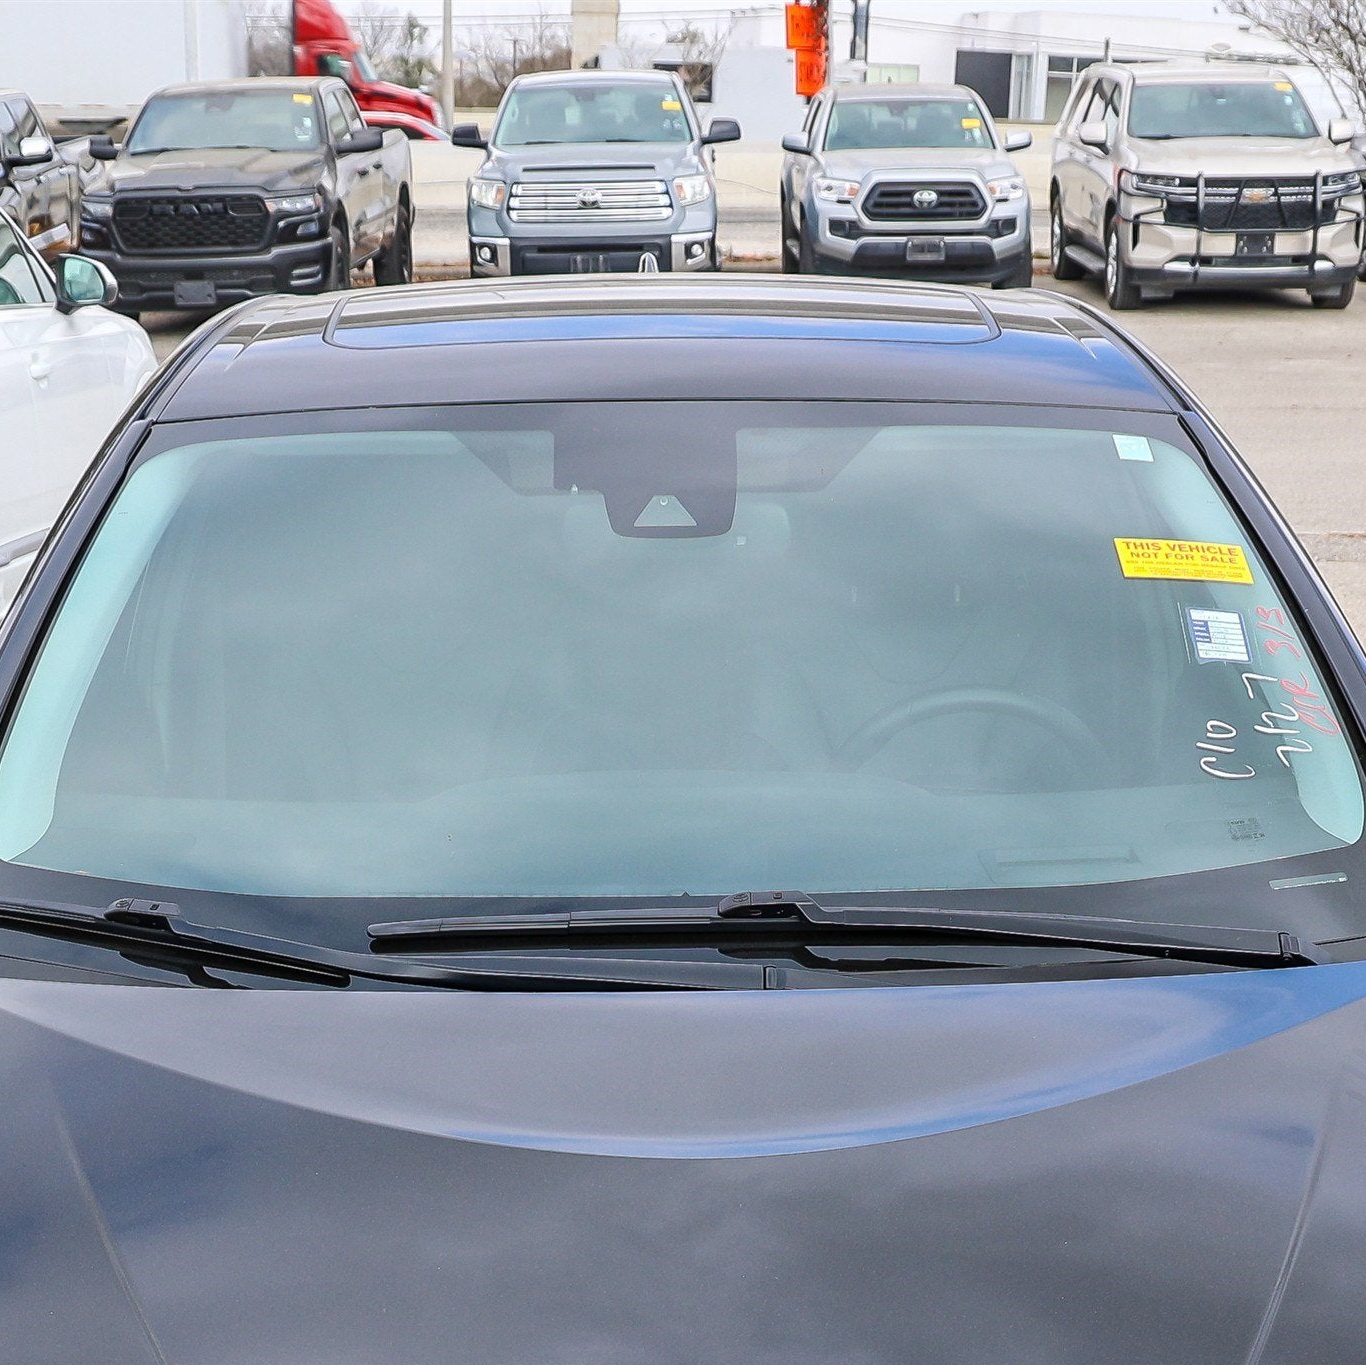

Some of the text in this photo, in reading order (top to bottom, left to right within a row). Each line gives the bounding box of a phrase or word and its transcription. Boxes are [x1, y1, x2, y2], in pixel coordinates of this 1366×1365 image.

[1122, 541, 1239, 557] THIS VEHICLE
[1165, 553, 1195, 561] FOR
[1200, 554, 1238, 564] SALE
